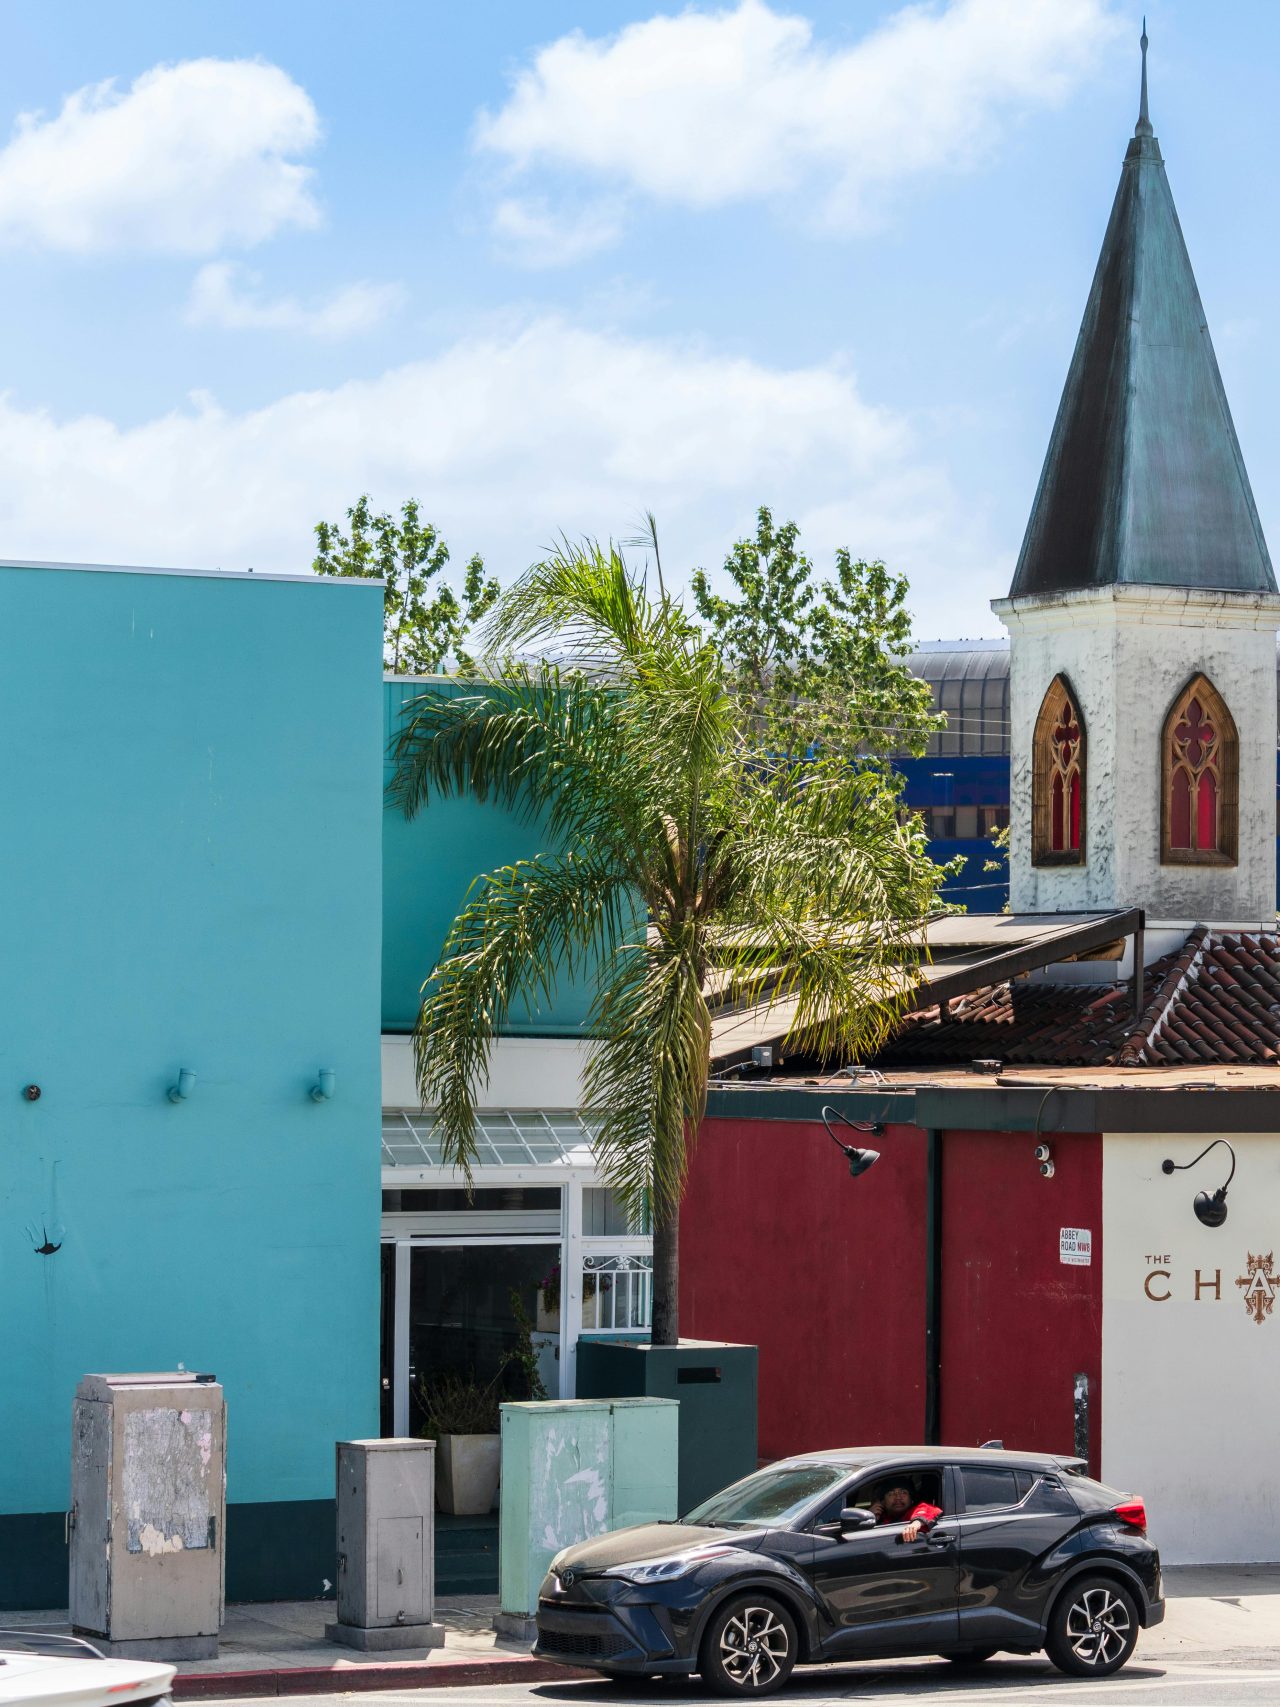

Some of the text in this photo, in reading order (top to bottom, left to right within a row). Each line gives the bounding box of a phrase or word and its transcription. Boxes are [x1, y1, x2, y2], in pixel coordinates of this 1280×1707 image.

[1060, 1229, 1079, 1240] ABBEY
[1060, 1240, 1077, 1251] ROAD
[1144, 1255, 1172, 1265] THE
